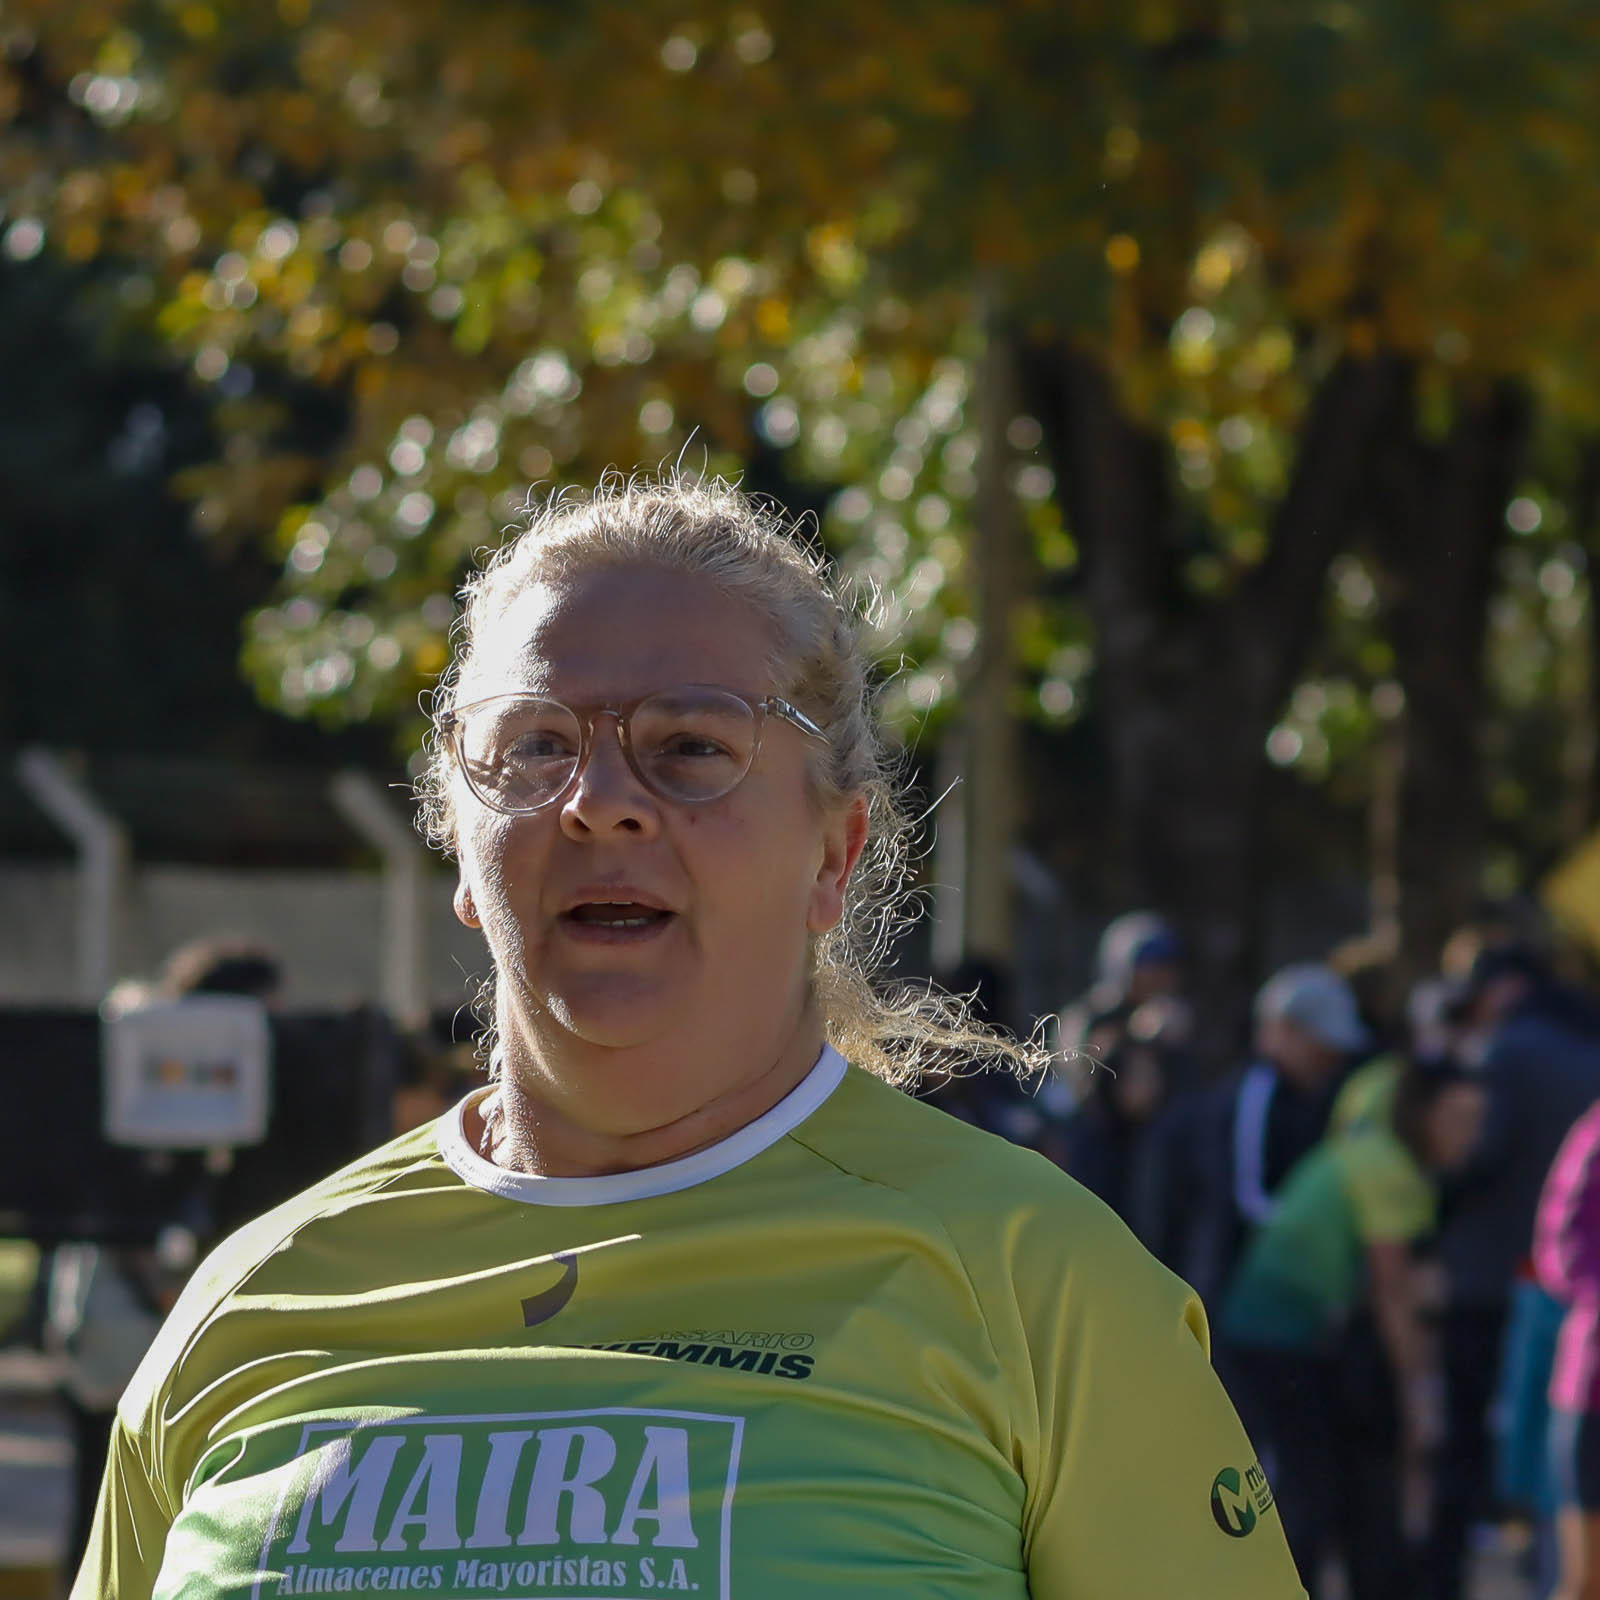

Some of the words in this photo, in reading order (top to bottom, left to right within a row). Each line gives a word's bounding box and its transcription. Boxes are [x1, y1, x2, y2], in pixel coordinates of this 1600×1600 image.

[286, 1425, 699, 1554] MAIRA
[276, 1560, 444, 1596] Almacenes
[452, 1554, 627, 1593] Mayoristas
[638, 1557, 700, 1591] S.A.
